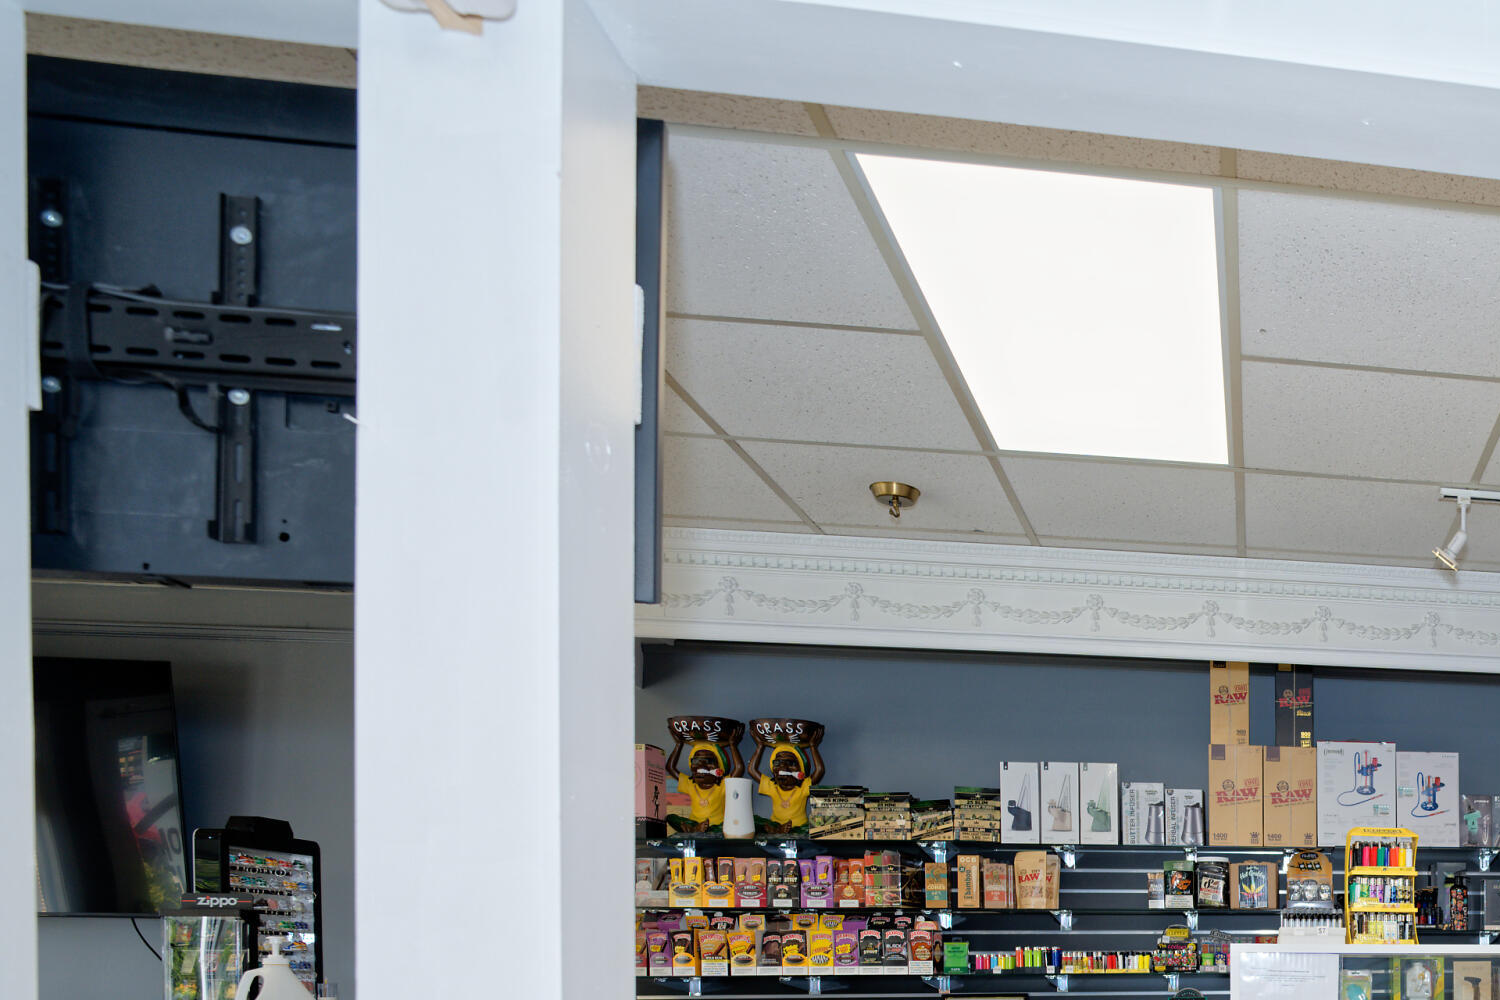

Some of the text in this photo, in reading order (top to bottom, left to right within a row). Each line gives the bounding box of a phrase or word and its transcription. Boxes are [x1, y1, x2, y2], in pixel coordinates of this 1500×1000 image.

[1214, 692, 1248, 704] RAW
[1216, 787, 1258, 804] RAW
[1271, 788, 1313, 805] RAW
[1018, 872, 1040, 884] RAW
